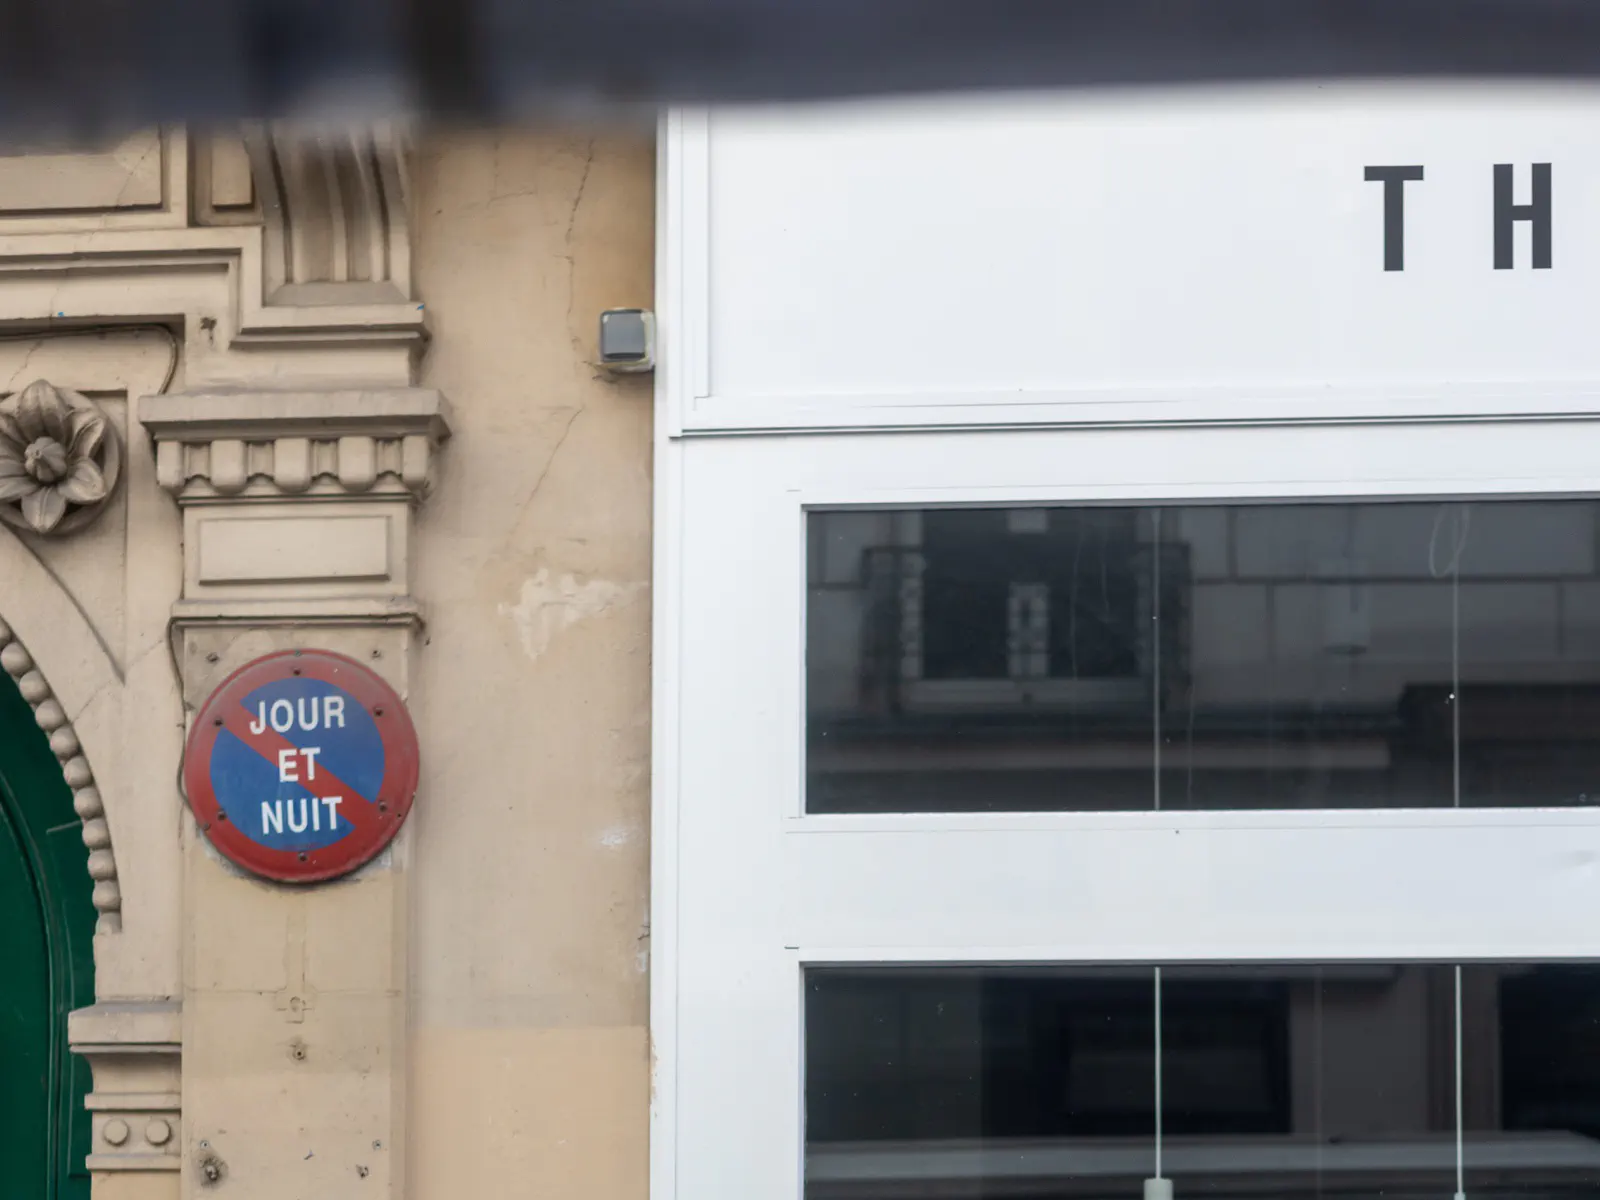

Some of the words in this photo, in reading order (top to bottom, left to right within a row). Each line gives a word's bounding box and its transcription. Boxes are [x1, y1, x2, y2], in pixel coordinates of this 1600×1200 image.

[1364, 163, 1552, 271] TH
[250, 696, 345, 735] JOUR
[278, 747, 321, 783] ET
[261, 796, 343, 835] NUIT
